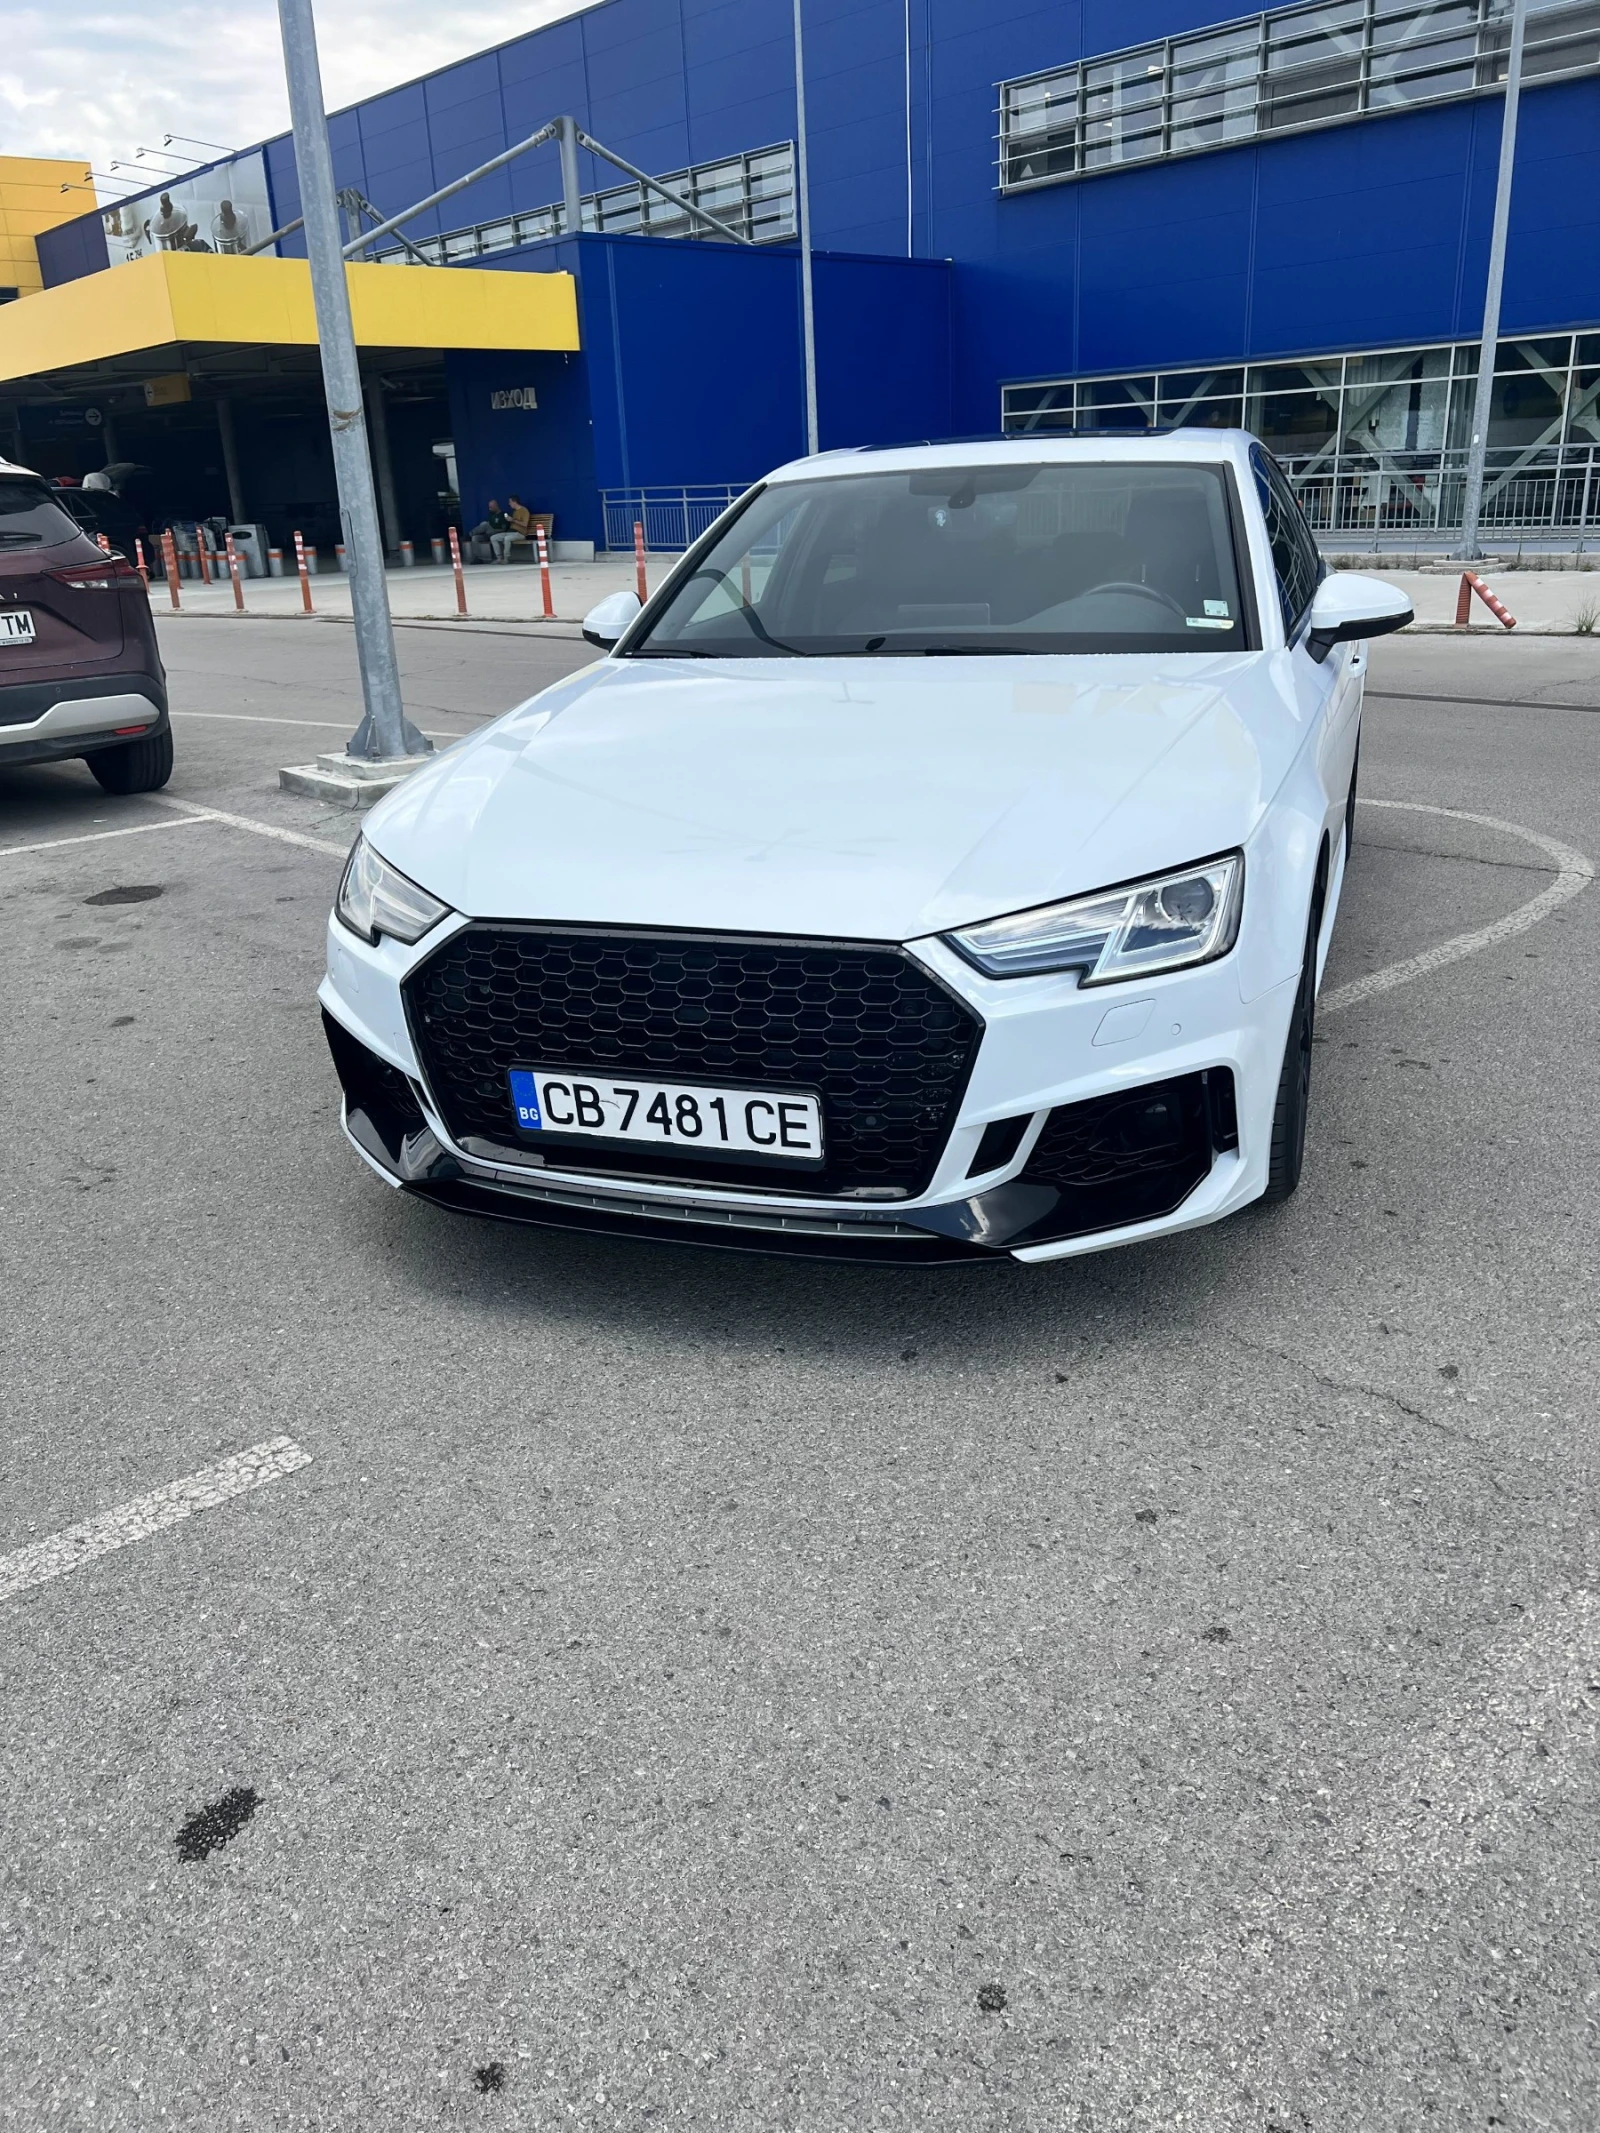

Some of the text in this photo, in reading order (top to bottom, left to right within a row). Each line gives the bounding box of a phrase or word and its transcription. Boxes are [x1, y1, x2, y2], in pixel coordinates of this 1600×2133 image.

[491, 387, 538, 410] ИЗХОД
[1, 615, 32, 635] TM
[519, 1107, 539, 1120] BG
[543, 1082, 812, 1149] CB 7481 CE
